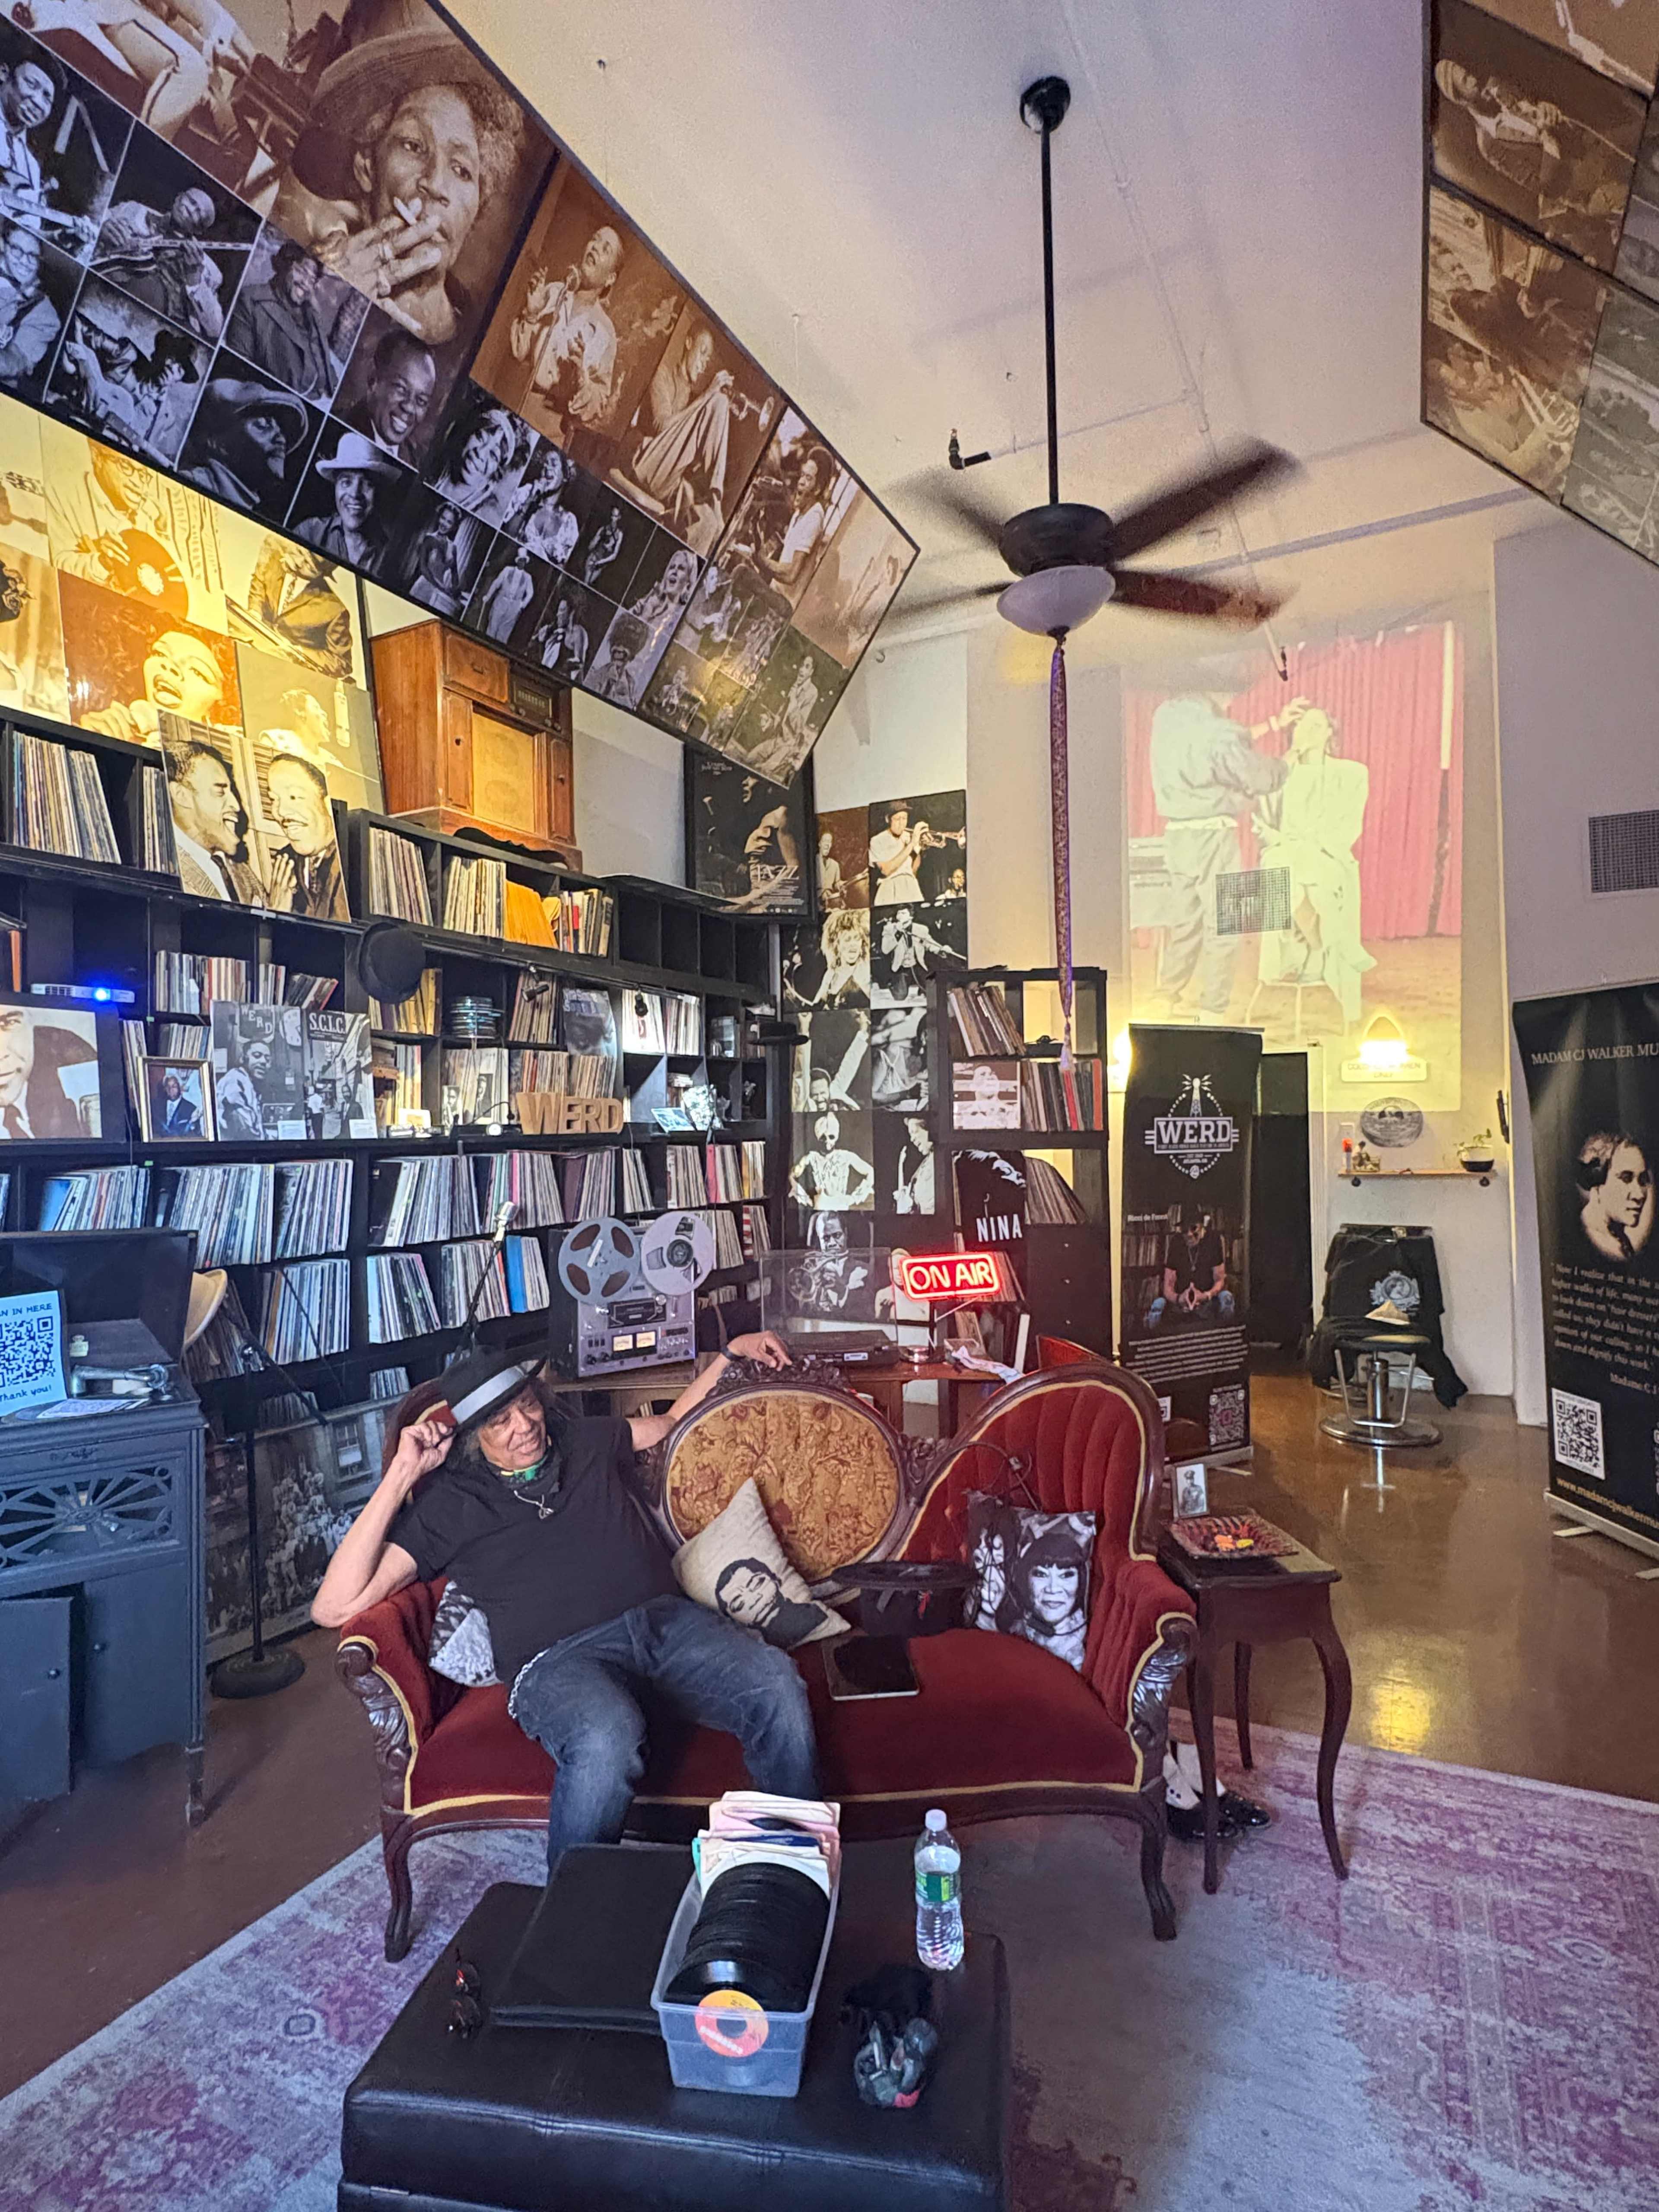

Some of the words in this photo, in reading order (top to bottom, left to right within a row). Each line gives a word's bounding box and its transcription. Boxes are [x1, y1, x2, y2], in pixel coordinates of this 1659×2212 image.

[755, 864, 799, 883] JAZZ
[240, 1004, 273, 1034] WERD
[1531, 1050, 1572, 1065] MADAM
[1573, 1050, 1585, 1062] CJ
[1587, 1045, 1634, 1059] WALKER
[515, 1092, 624, 1135] WERD
[1157, 1120, 1230, 1144] WERD
[976, 1214, 1023, 1242] NINA
[909, 1265, 951, 1290] ON
[955, 1261, 994, 1288] AIR
[13, 1307, 22, 1316] IN
[26, 1302, 53, 1313] HERE
[31, 1384, 52, 1396] you!
